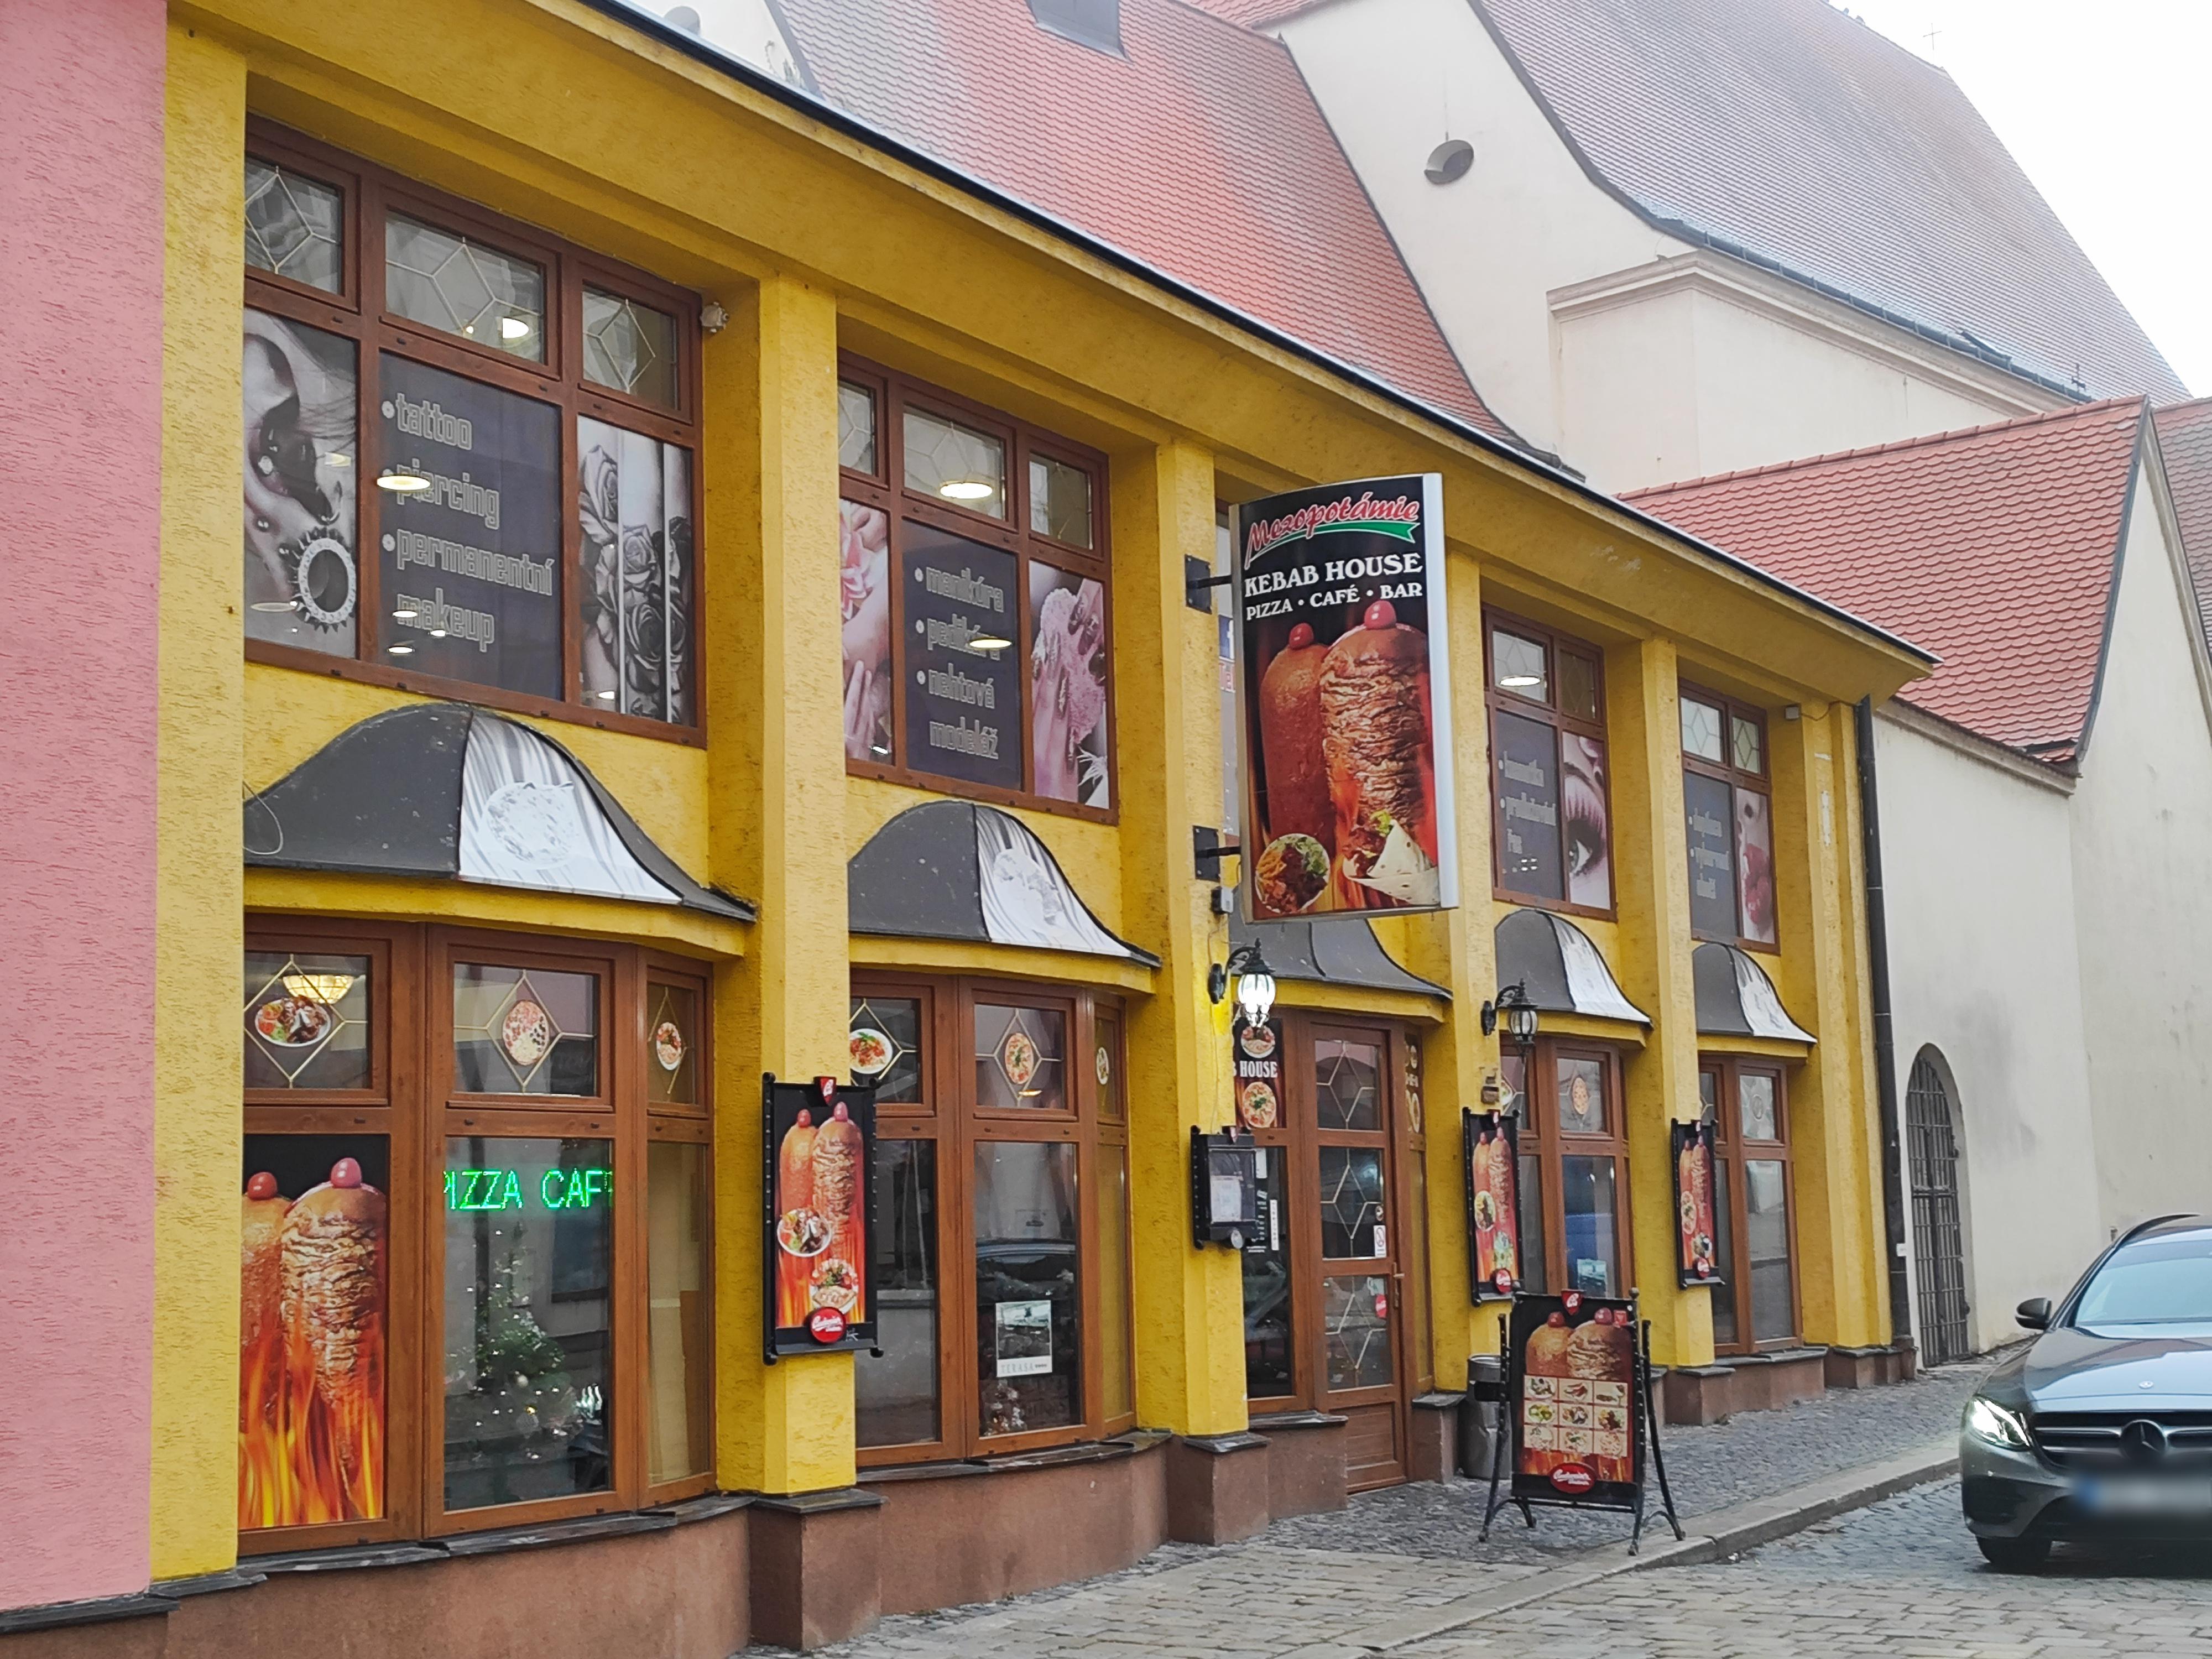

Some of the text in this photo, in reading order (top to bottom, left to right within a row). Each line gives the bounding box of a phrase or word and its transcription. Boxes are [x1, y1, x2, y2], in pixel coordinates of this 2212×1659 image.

[396, 393, 472, 450] tattoo
[397, 458, 500, 530] piercing
[1244, 491, 1420, 570] Mezopotámie
[397, 529, 555, 596] permanentní
[1244, 553, 1423, 597] KEBAB HOUSE
[926, 567, 1004, 612] manikúra
[1246, 582, 1423, 620] PIZZA CAFÉ BAR
[397, 587, 495, 653] makeup
[928, 662, 995, 708] nehtová
[930, 716, 999, 759] modeláž
[1240, 1060, 1278, 1078] HOUSE
[541, 1168, 612, 1209] CAF
